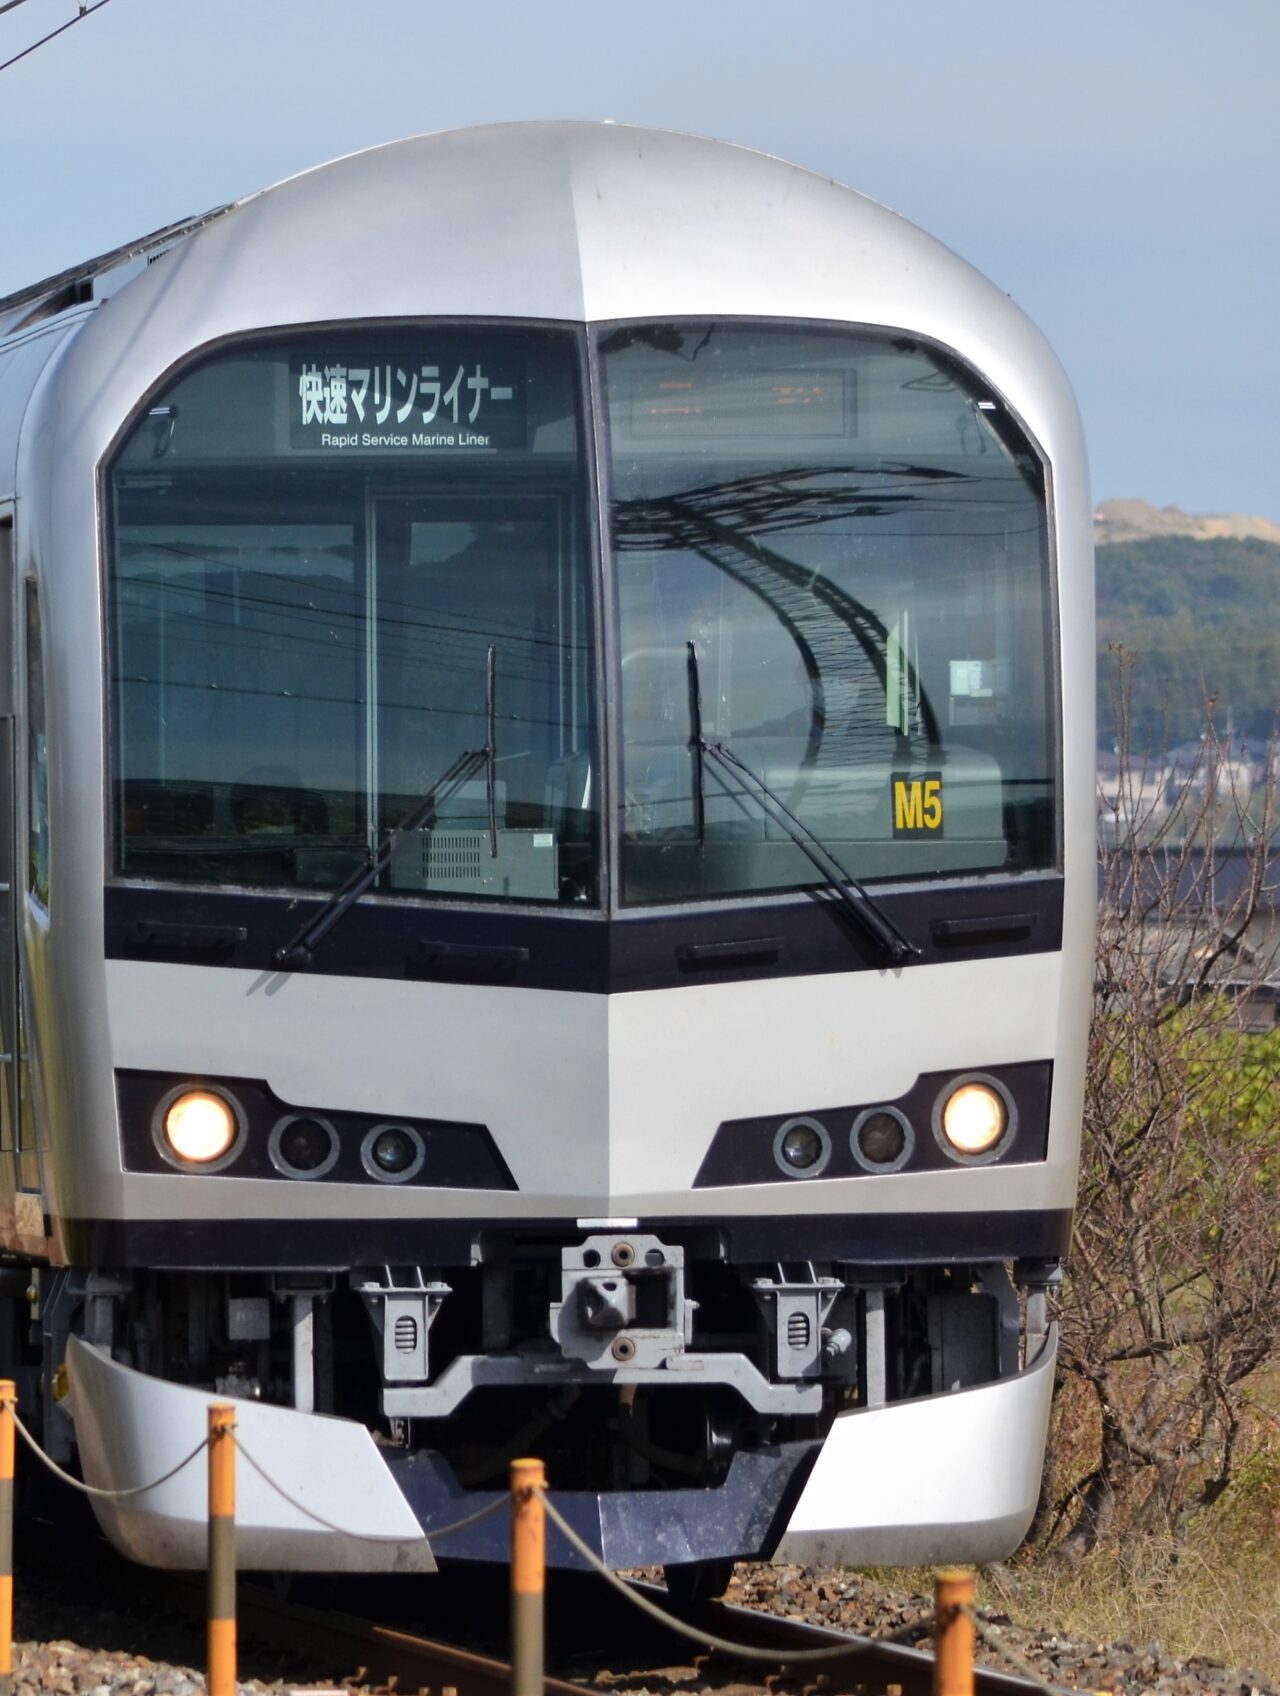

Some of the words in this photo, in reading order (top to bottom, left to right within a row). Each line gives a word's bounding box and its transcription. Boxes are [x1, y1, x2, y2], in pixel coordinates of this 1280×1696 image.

[299, 363, 513, 426] 快速マリンライナー
[321, 433, 358, 448] Rapid
[361, 433, 409, 446] Service
[412, 432, 455, 446] Marine
[458, 432, 489, 446] Liner
[894, 780, 942, 829] M5
